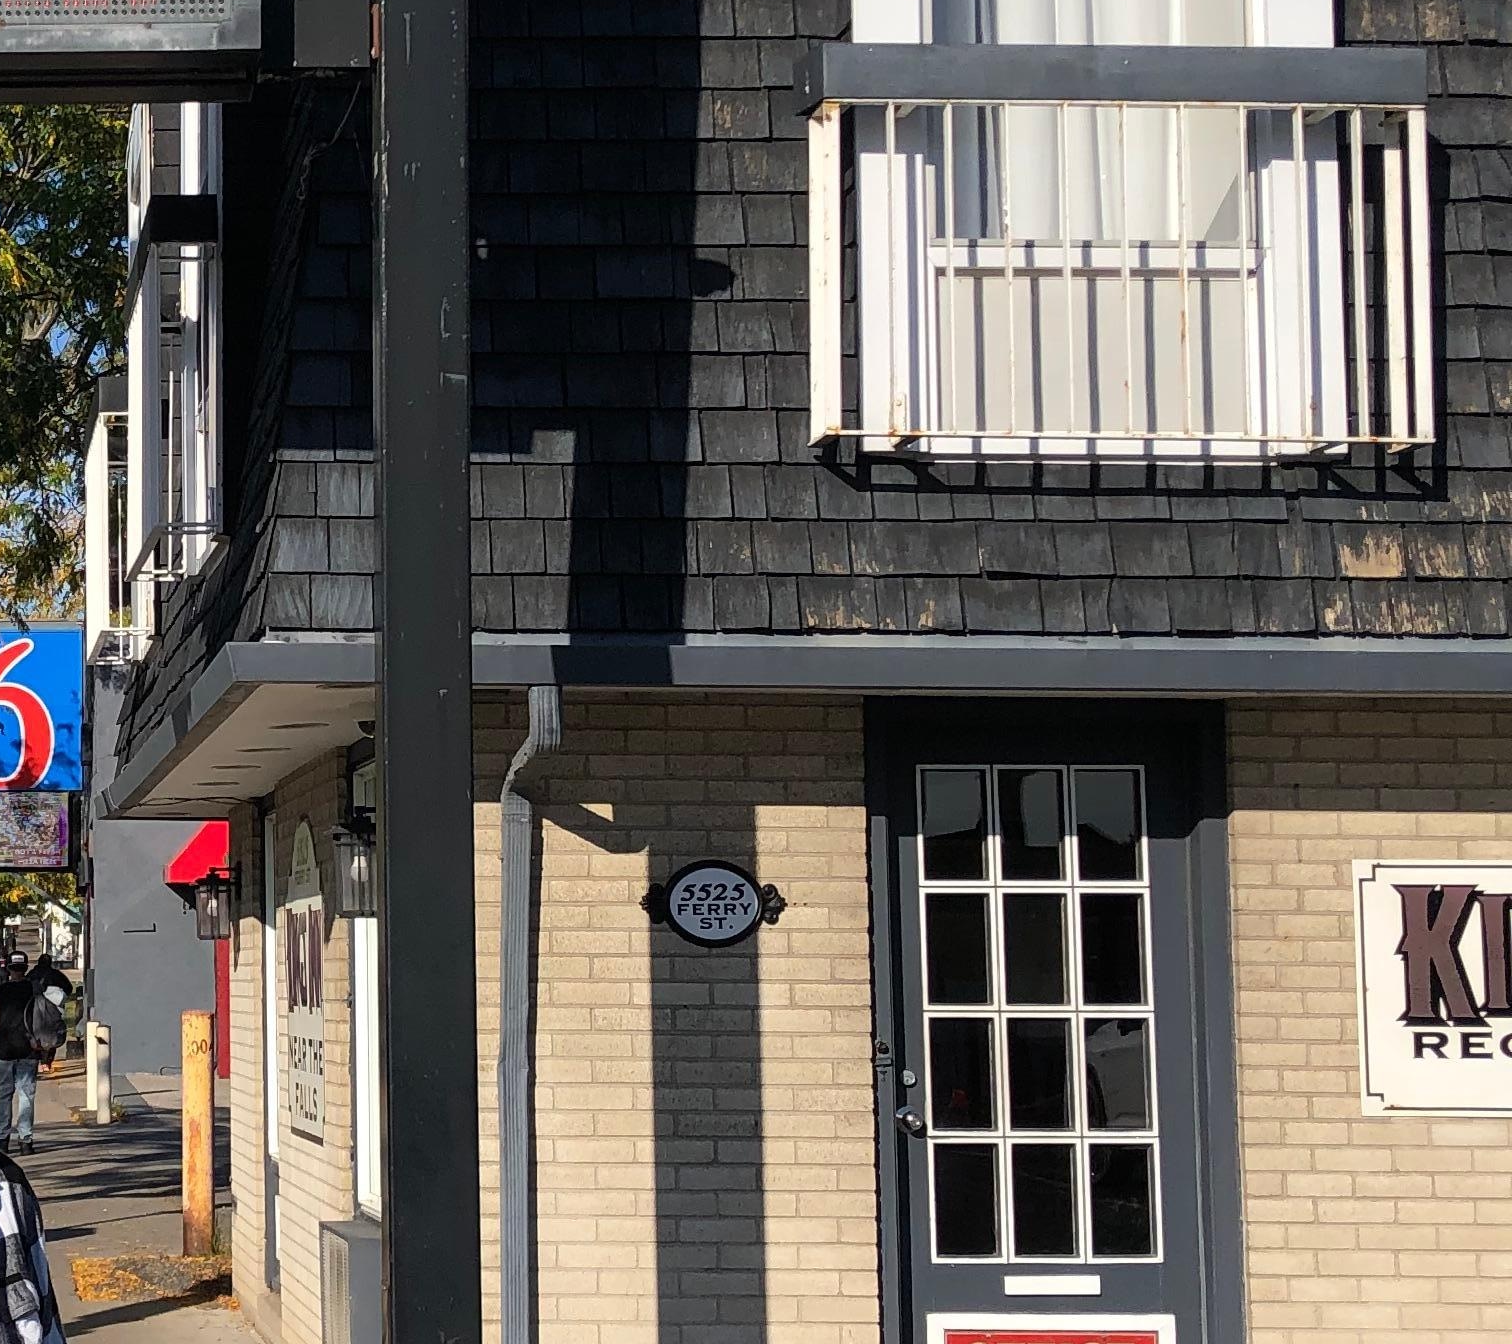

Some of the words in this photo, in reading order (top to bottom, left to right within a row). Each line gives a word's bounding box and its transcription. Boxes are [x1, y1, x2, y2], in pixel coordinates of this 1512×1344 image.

[680, 883, 746, 902] 5525
[677, 902, 752, 916] FERRY
[699, 917, 734, 930] ST.
[1390, 883, 1512, 1028] KI
[289, 1035, 307, 1074] NEAR
[308, 1037, 323, 1076] THE
[295, 1081, 318, 1123] FALLS
